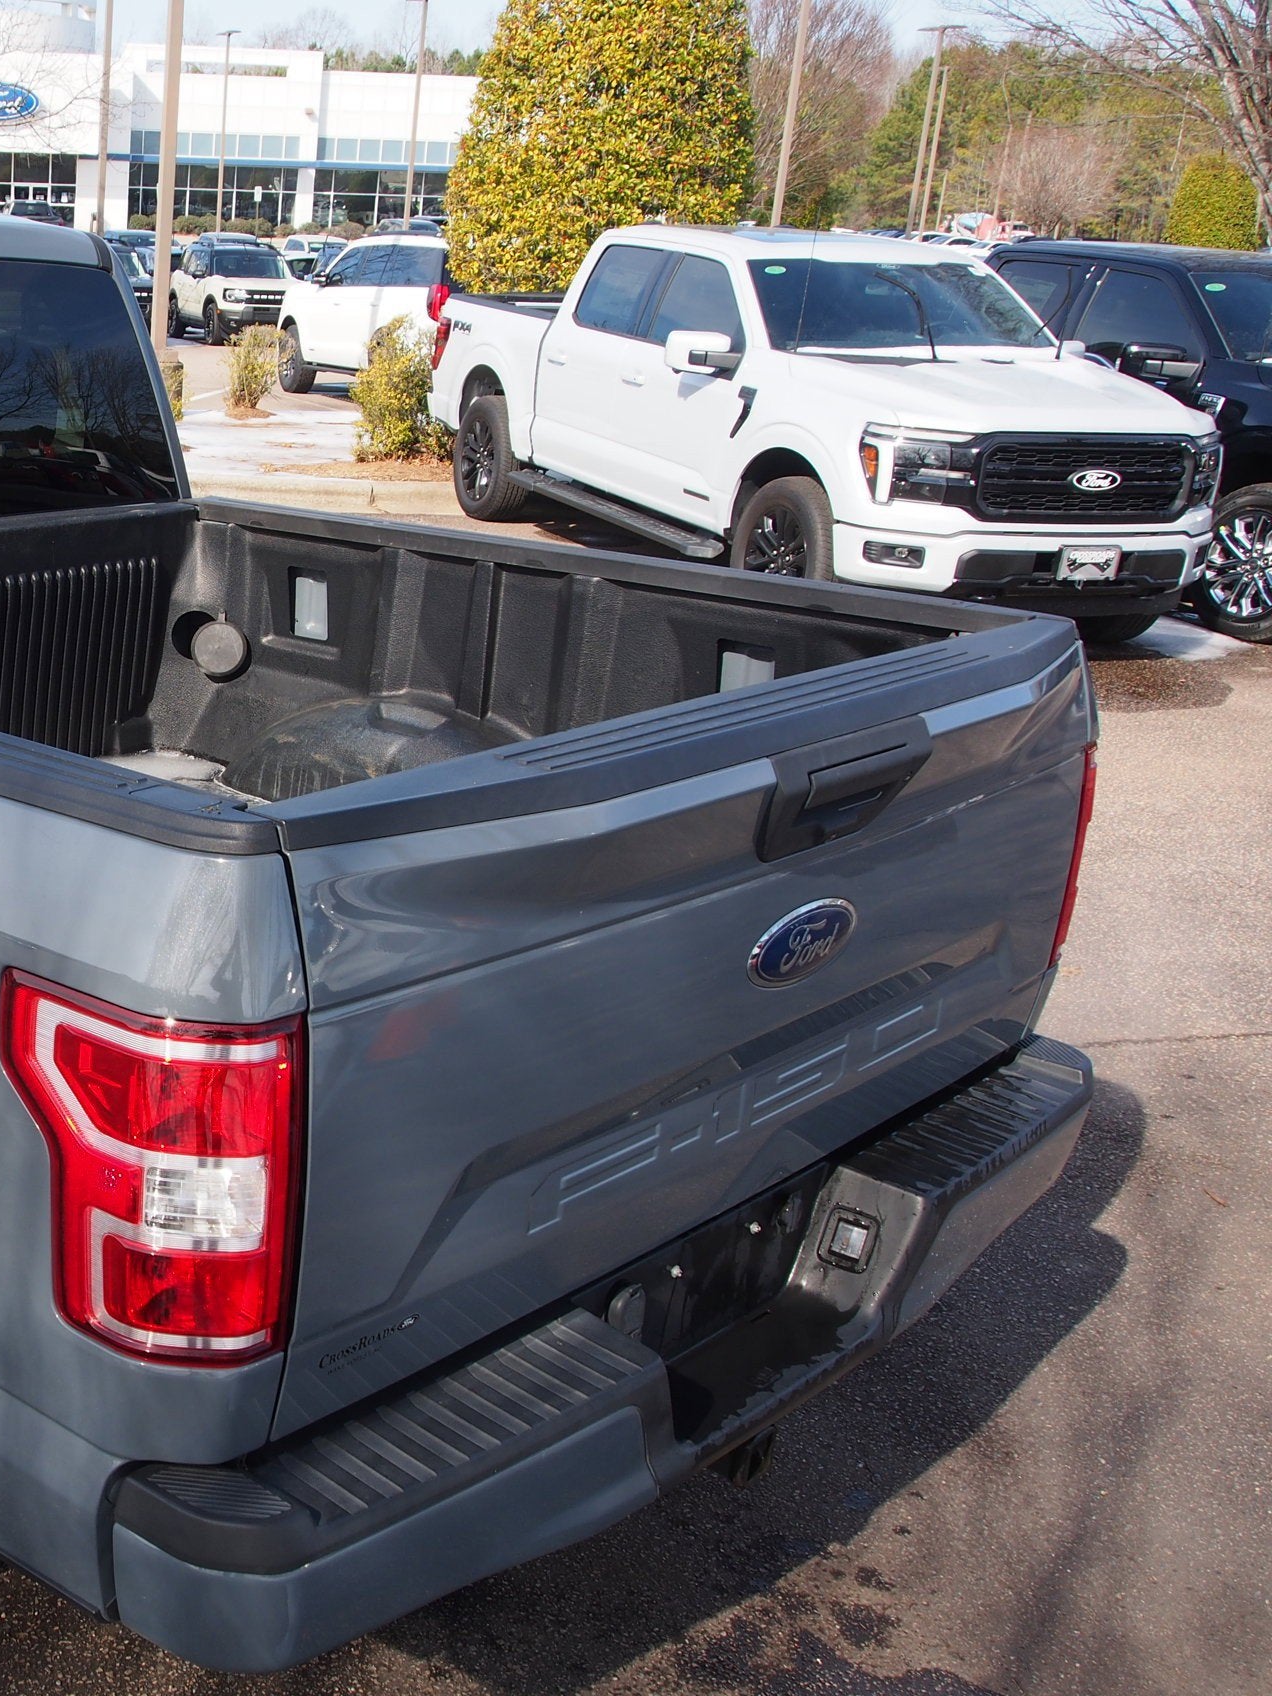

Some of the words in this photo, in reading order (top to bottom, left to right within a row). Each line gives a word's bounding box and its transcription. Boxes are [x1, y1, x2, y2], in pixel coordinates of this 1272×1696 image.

[453, 320, 472, 333] FX4
[1081, 473, 1112, 487] Ford
[779, 919, 840, 974] Ford
[528, 998, 943, 1236] F-150
